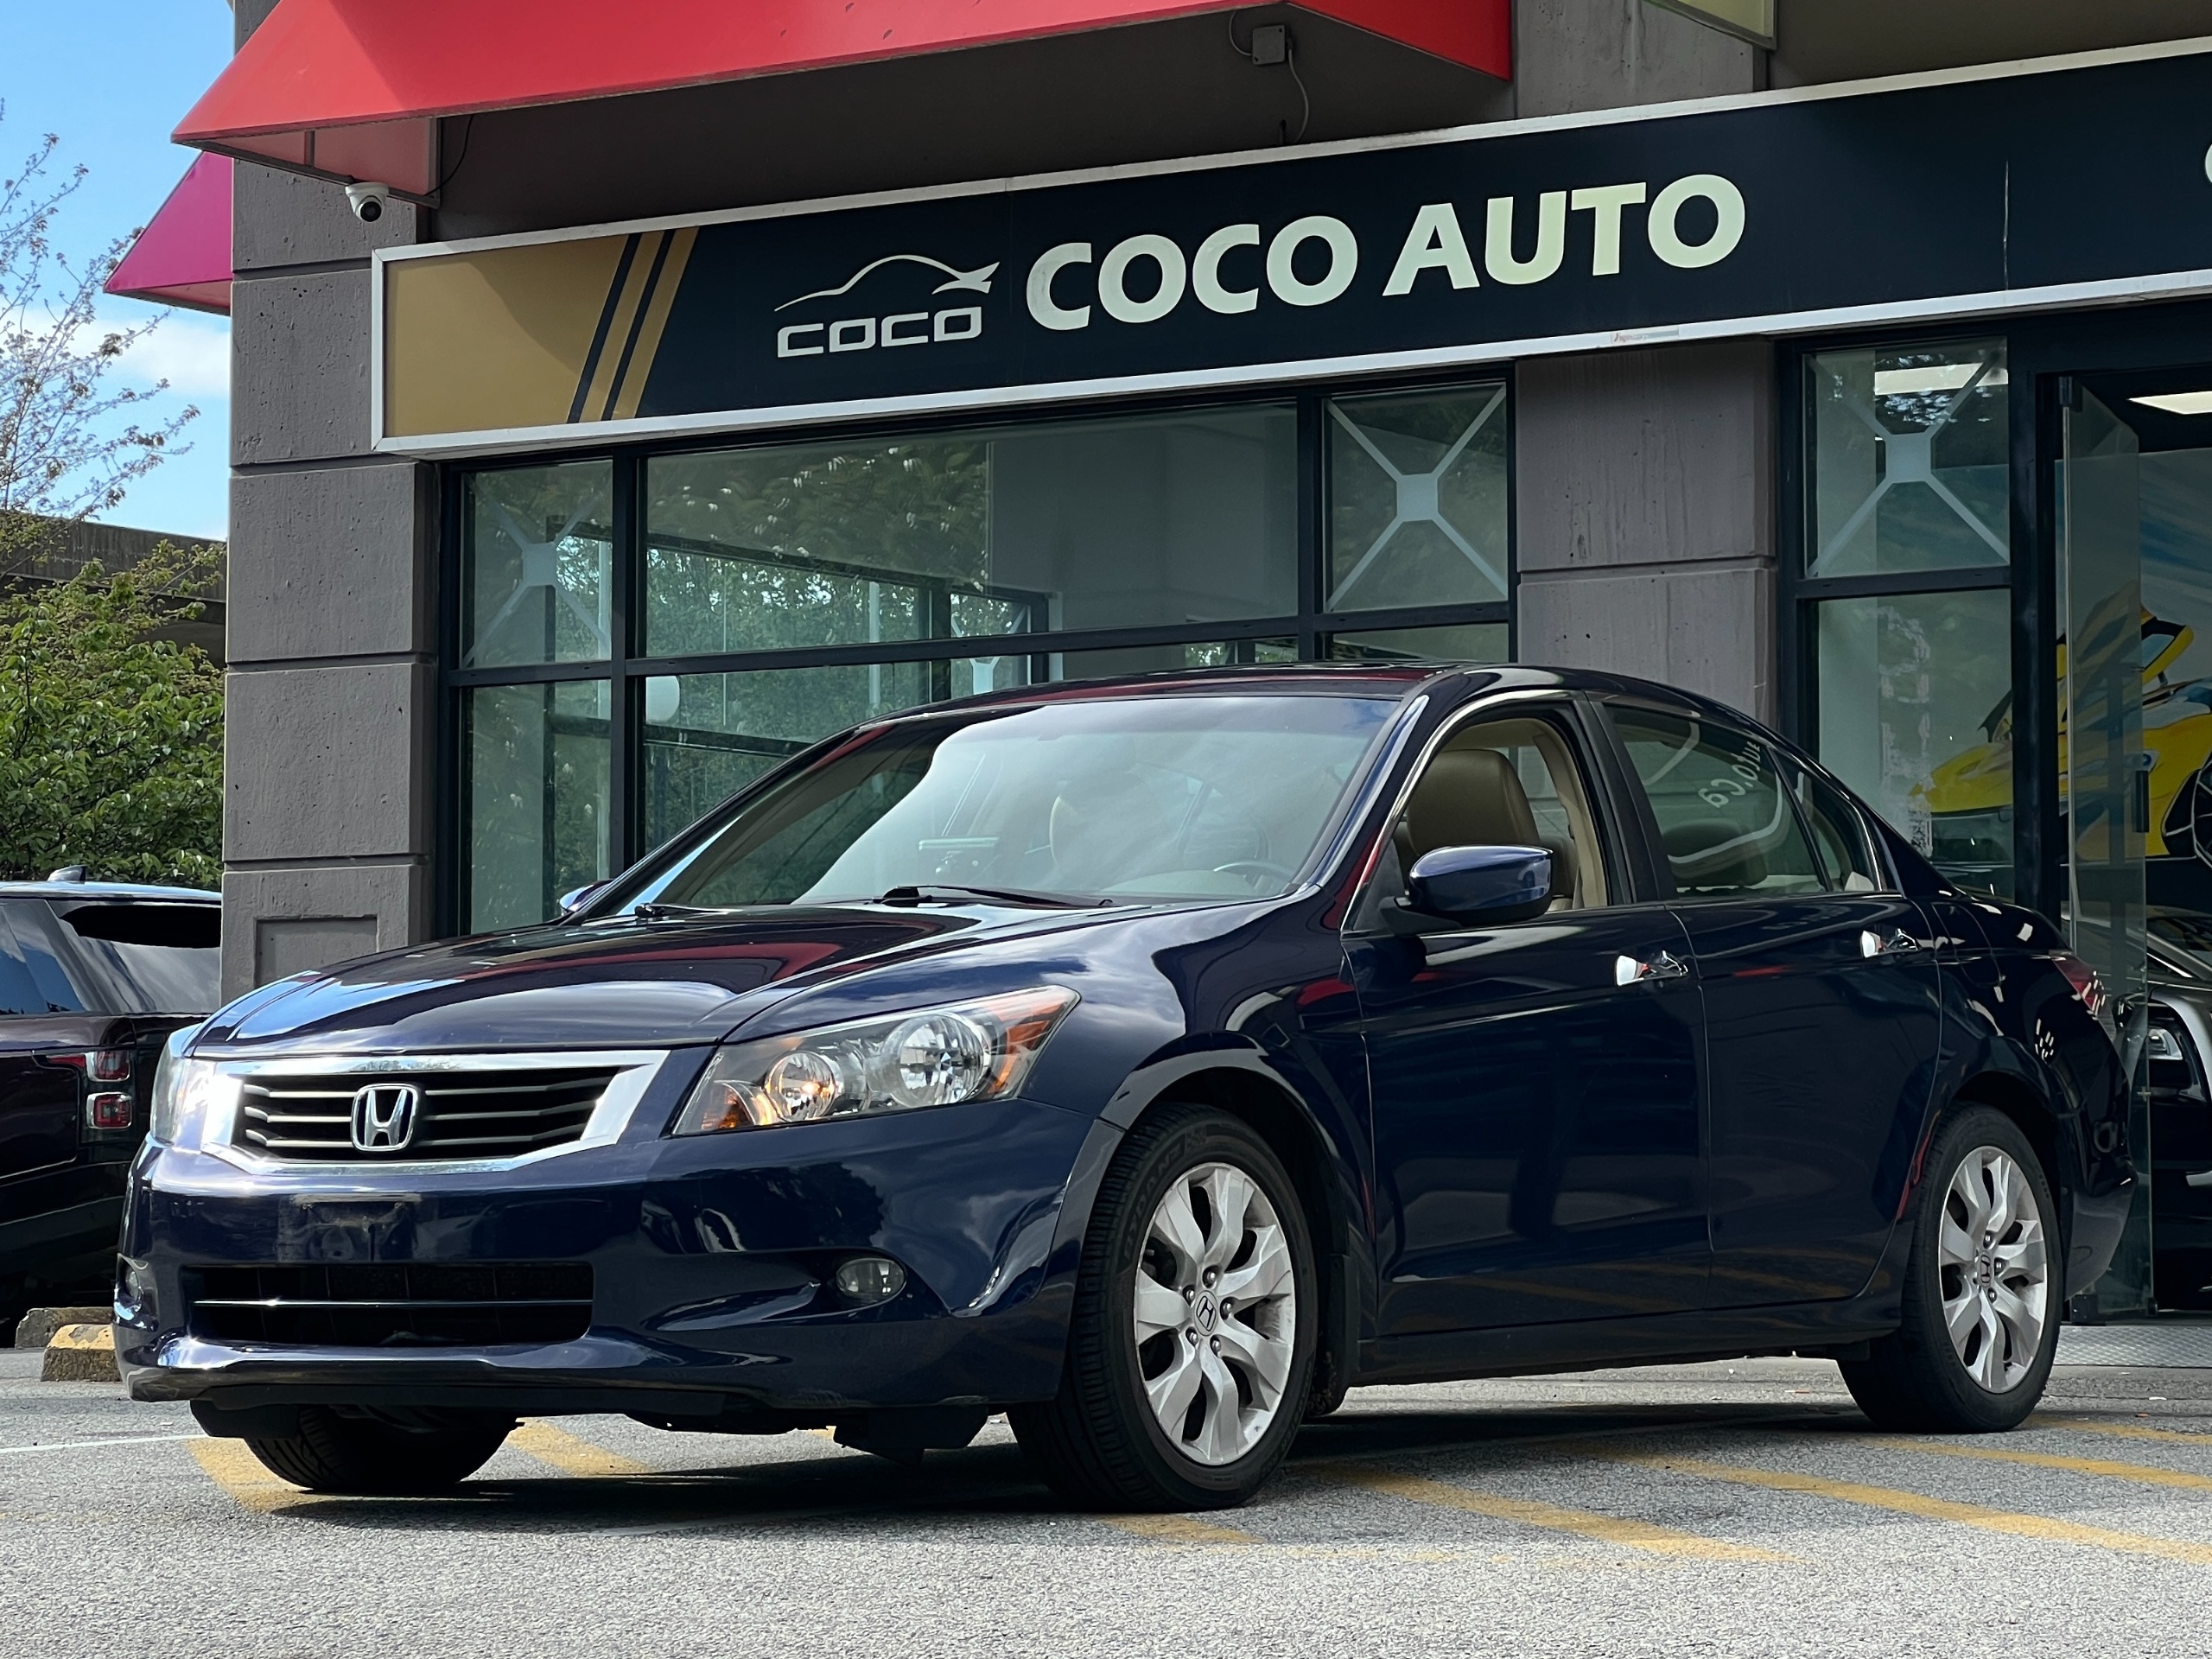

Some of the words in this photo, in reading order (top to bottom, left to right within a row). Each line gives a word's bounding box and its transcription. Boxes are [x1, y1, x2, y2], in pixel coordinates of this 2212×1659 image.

[1027, 216, 1357, 331] COCO
[1382, 175, 1745, 296] AUTO
[778, 307, 982, 358] COCO
